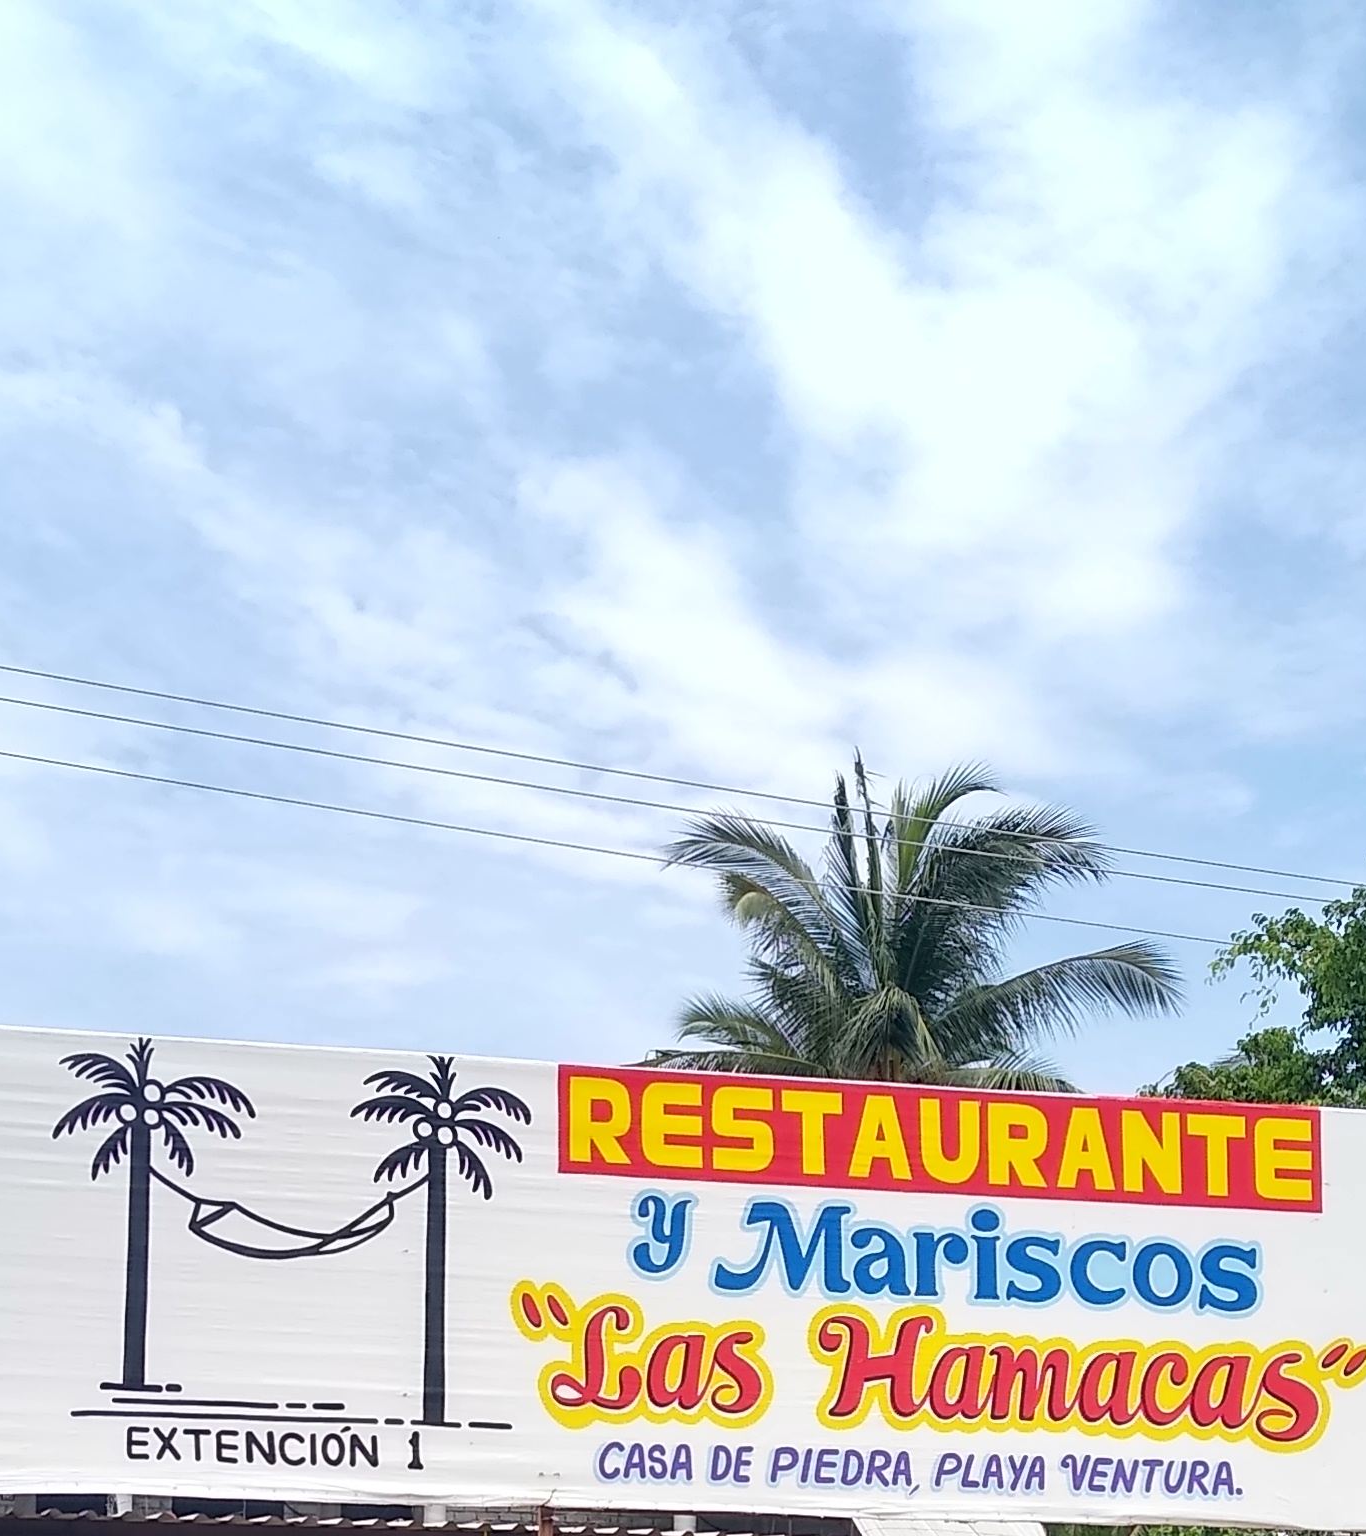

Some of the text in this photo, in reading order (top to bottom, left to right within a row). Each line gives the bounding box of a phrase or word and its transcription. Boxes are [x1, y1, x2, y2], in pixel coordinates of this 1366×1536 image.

[569, 1075, 1315, 1202] RESTAURANTE
[714, 1201, 1260, 1312] Mariscos
[126, 1425, 425, 1470] EXTENCIÓN 1
[598, 1441, 1244, 1497] CASA DE PIEDRA, PLAYA VENTURA.
